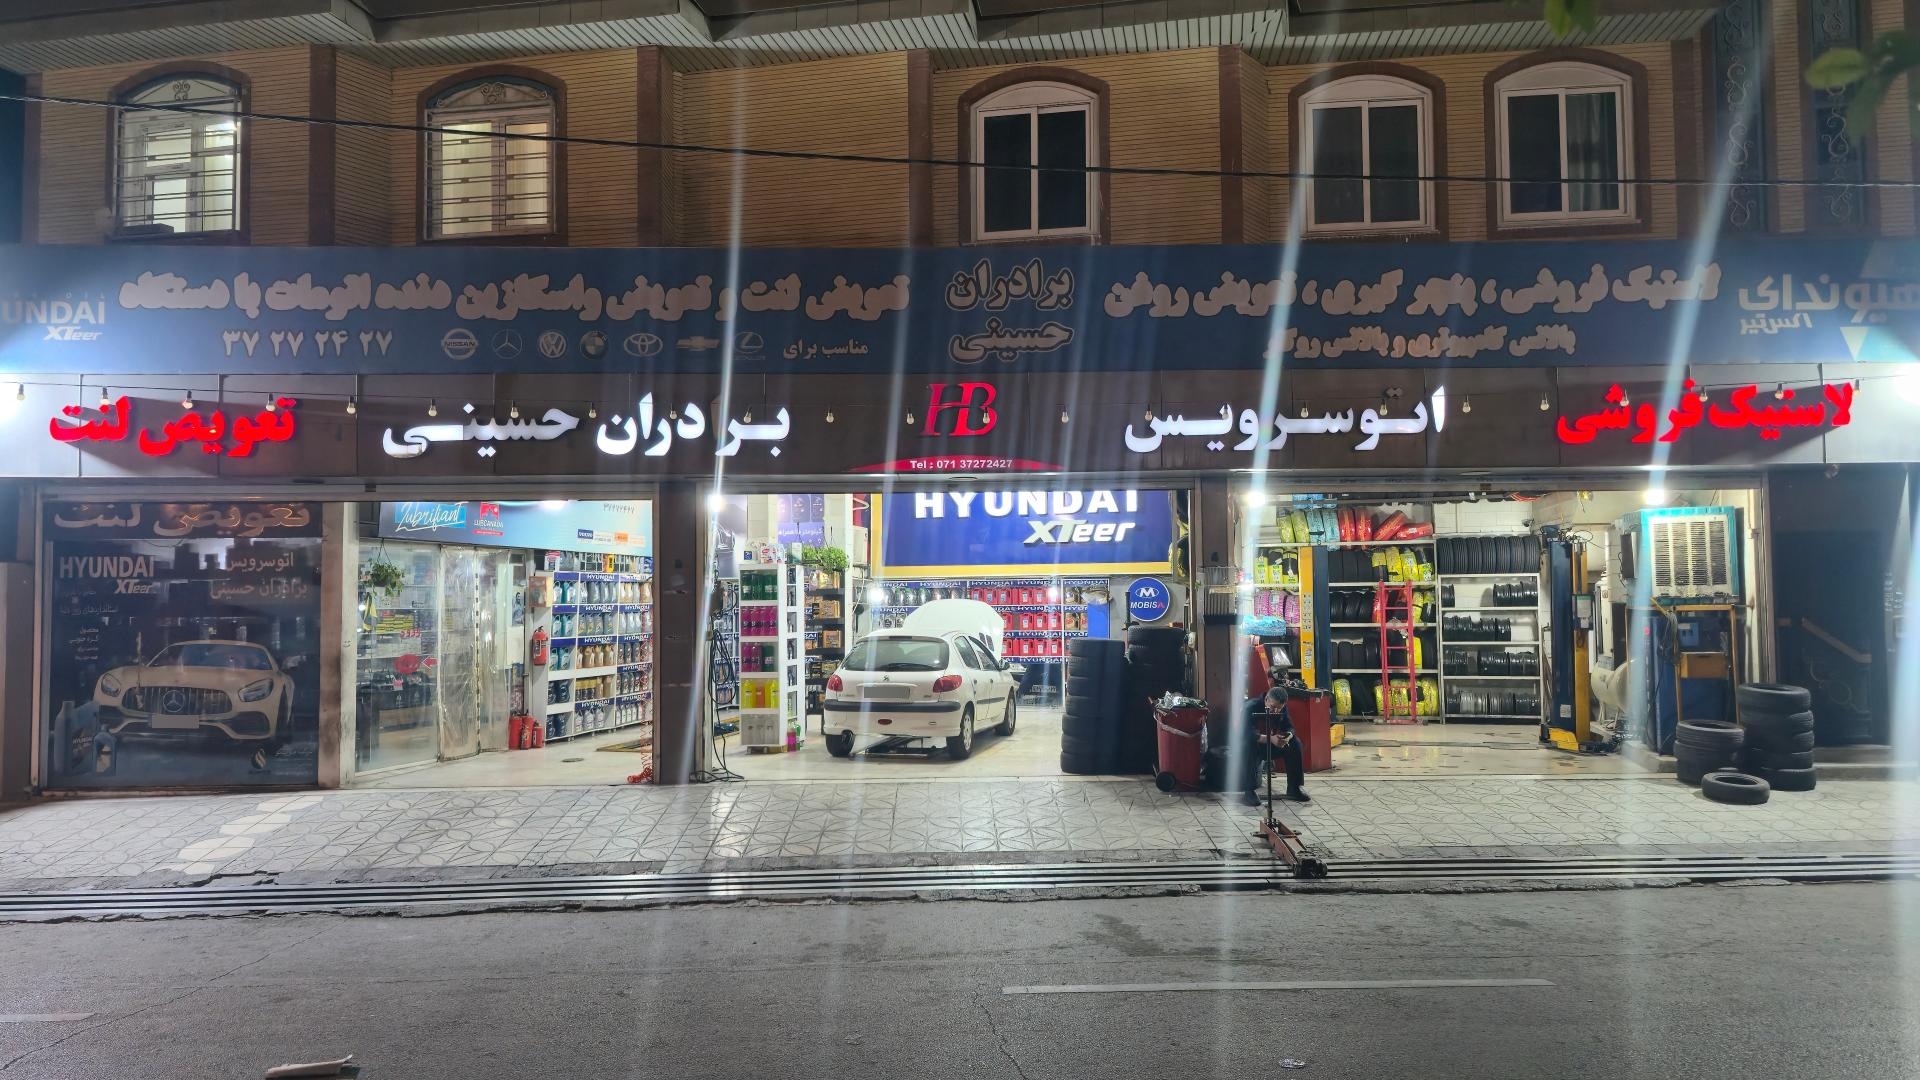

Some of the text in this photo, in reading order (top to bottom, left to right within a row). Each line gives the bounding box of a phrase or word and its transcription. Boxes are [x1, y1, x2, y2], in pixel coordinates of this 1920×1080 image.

[118, 271, 231, 309] دستگاه
[234, 271, 262, 319] با
[374, 272, 453, 310] دنده
[606, 274, 713, 322] تعویض
[741, 272, 802, 312] لنت
[805, 274, 911, 322] تعویض
[945, 258, 1074, 311] برادران
[1104, 271, 1190, 318] روغن
[1193, 270, 1298, 318] تعویض
[1613, 262, 1722, 310] لاستیک
[43, 325, 103, 341] XTeer
[221, 330, 393, 357] ۳۷ ۲۷ ۲۴ ۲۷
[783, 337, 869, 360] مناسب برای
[948, 316, 1074, 363] حسینی
[49, 395, 297, 457] تعویض لنت
[382, 391, 791, 458] برادران حسینی
[1124, 385, 1446, 453] اتوسرویس
[1557, 377, 1854, 445] لاستیک فروشی
[910, 461, 927, 469] Tel
[937, 461, 955, 469] 071
[960, 460, 1013, 469] 37272427
[54, 503, 310, 537] تعویض لنت
[915, 490, 1139, 519] HYUNDAI
[1024, 520, 1136, 545] XTeer
[59, 556, 155, 579] HYUNDAI
[226, 552, 294, 571] اتوسرویس
[114, 579, 151, 594] XTeer
[210, 577, 308, 600] برادران حسینی
[1130, 601, 1166, 609] MOBISA
